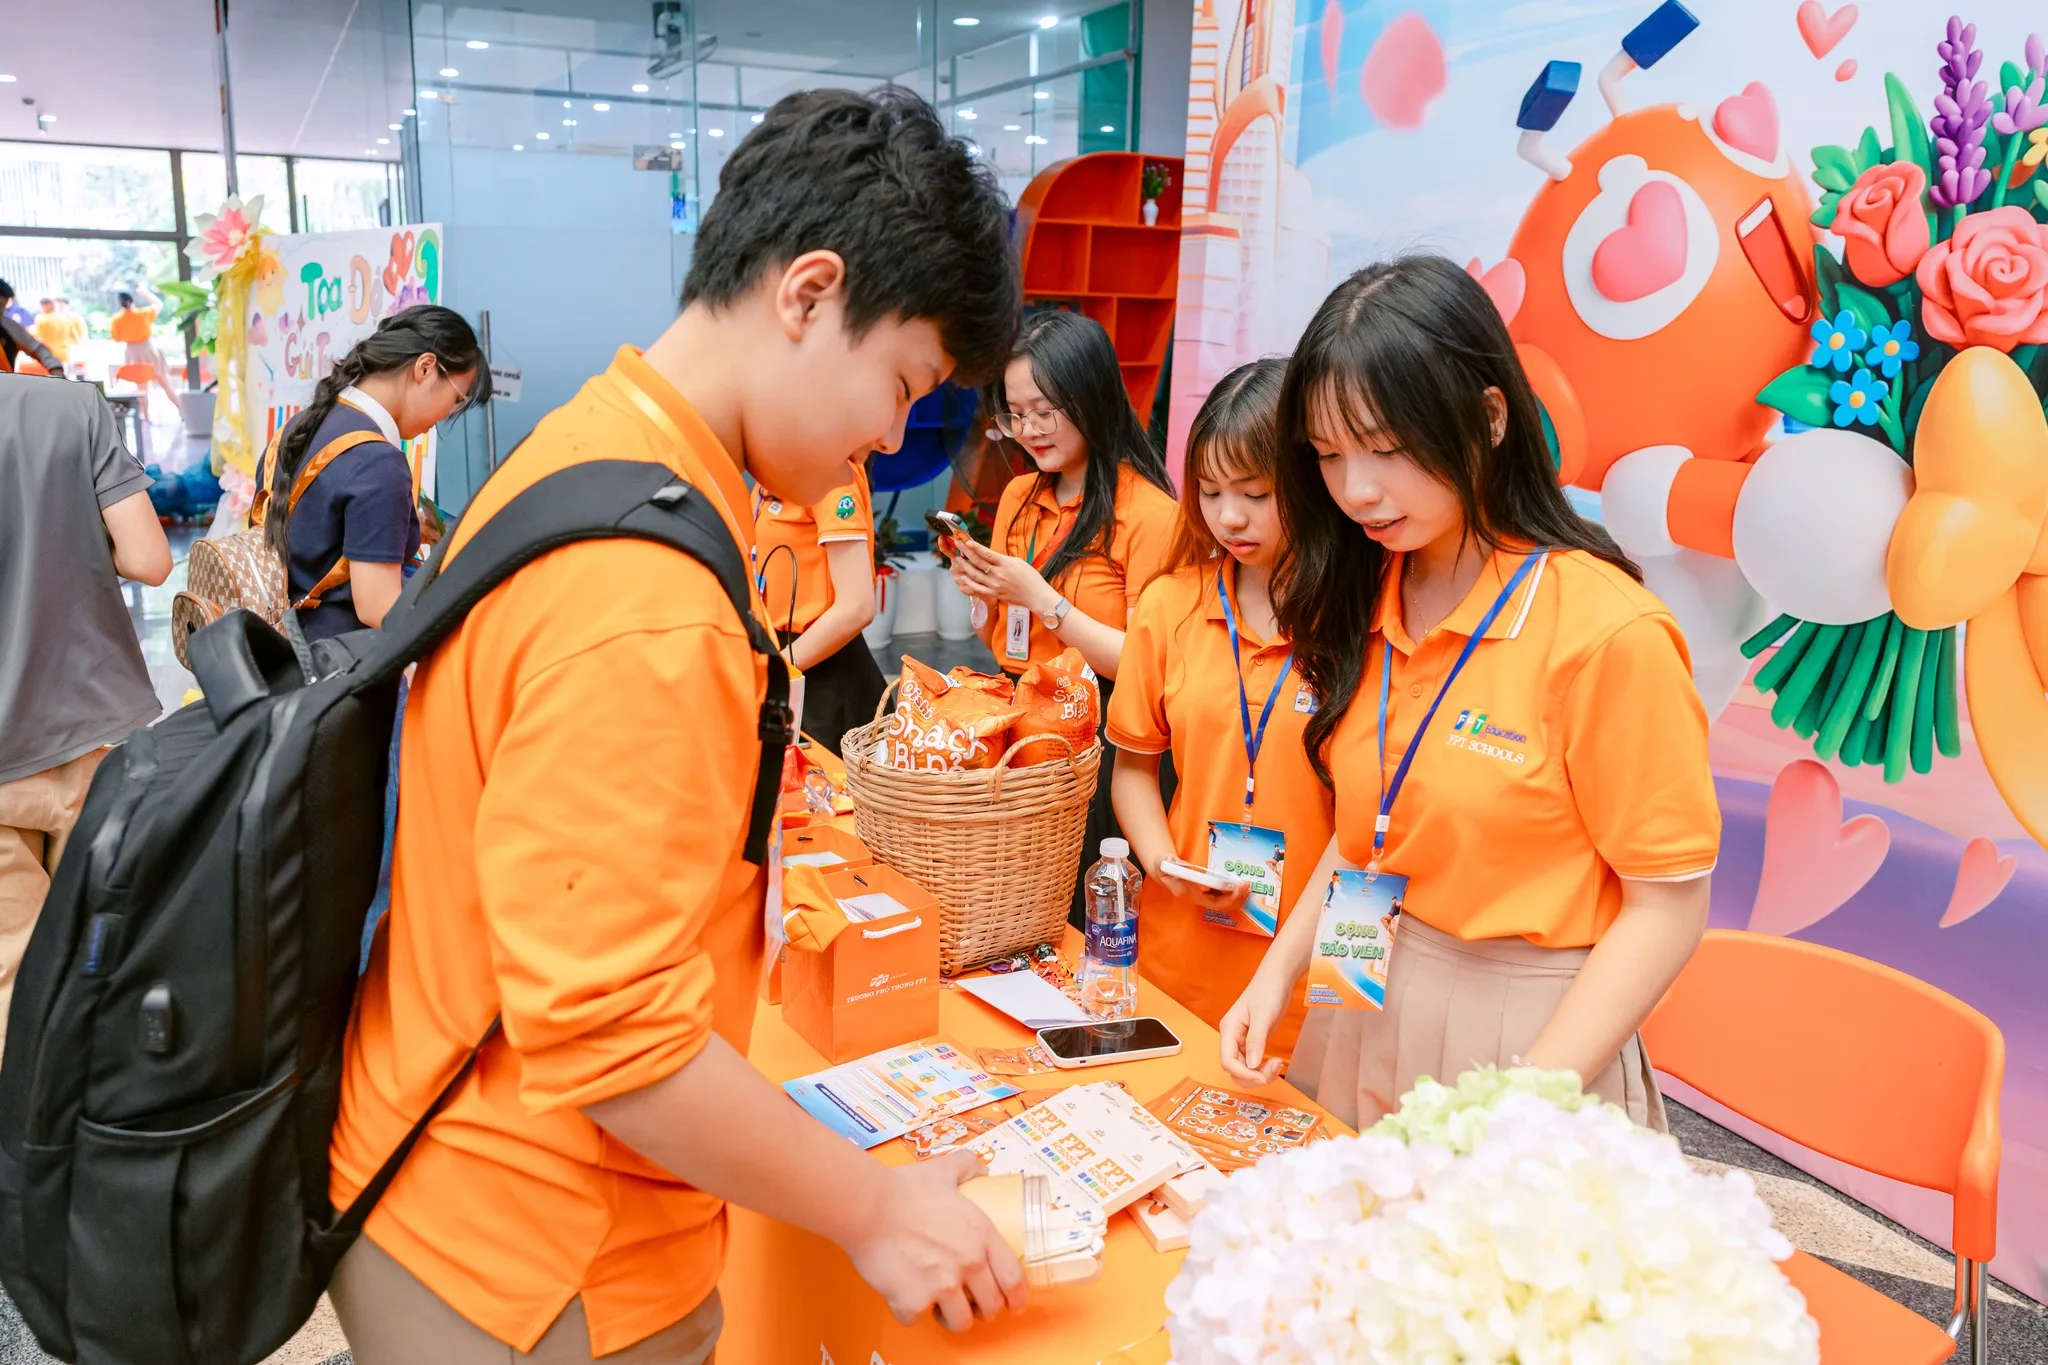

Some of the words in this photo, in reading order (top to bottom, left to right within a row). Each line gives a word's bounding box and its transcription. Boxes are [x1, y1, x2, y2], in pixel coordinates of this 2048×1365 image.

[901, 680, 934, 719] Oishi
[889, 701, 988, 759] Snack
[1455, 711, 1487, 733] FPT
[1485, 724, 1527, 743] Education
[1446, 734, 1467, 748] FPT
[1468, 740, 1525, 764] SCHOOLS
[1224, 860, 1265, 877] CỘNG
[1250, 881, 1274, 896] IÊN
[1335, 920, 1378, 940] CỘNG
[1351, 943, 1385, 960] VIÊN
[1023, 1114, 1051, 1137] SCHOOLS
[1030, 1105, 1067, 1131] FPT
[1051, 1141, 1080, 1166] SCHOOLS
[1058, 1133, 1096, 1161] FPT
[1088, 1167, 1118, 1193] SCHOOLS
[1095, 1157, 1135, 1186] FPT
